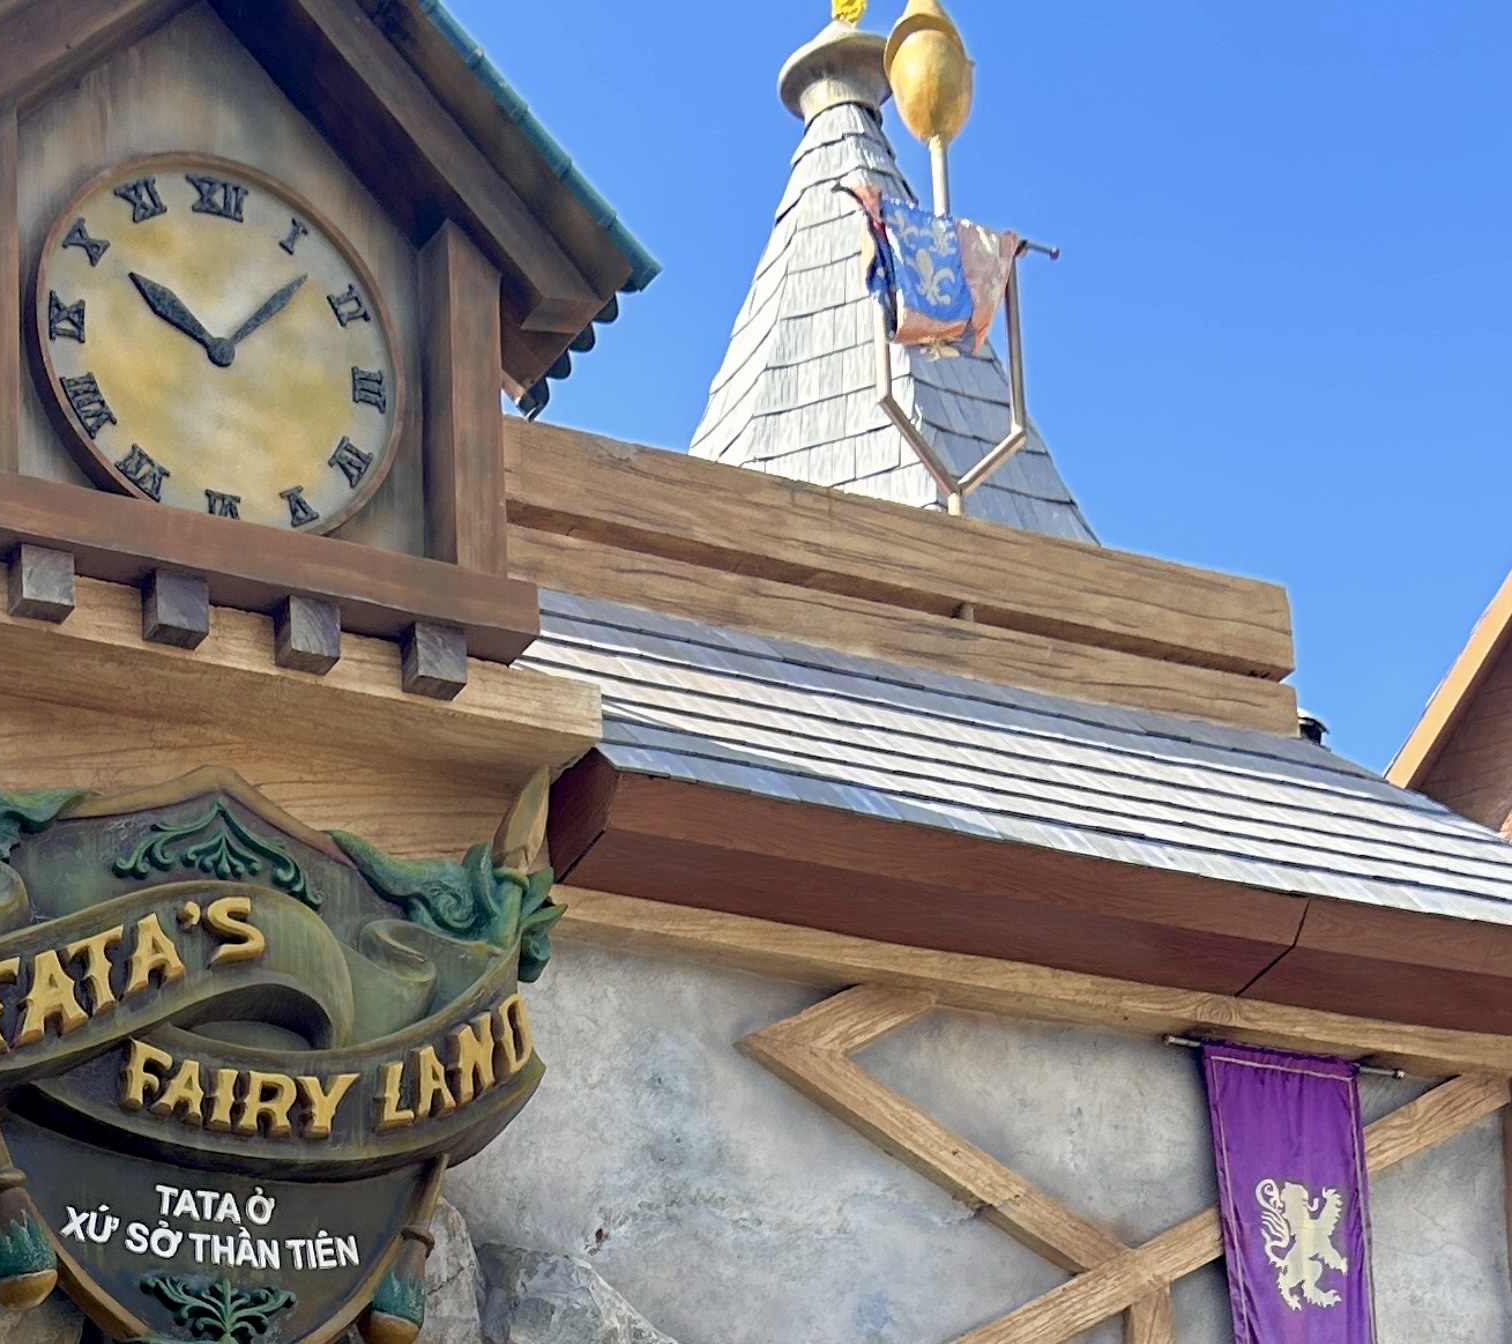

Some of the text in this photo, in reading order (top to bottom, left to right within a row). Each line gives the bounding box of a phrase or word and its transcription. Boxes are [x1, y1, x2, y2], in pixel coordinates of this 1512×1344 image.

[114, 177, 167, 223] XI
[186, 174, 249, 223] XII
[62, 217, 110, 267] X
[279, 217, 308, 255] I
[48, 290, 86, 343] IX
[327, 284, 371, 327] II
[59, 371, 117, 440] VIII
[352, 365, 387, 413] III
[114, 443, 170, 503] VII
[278, 485, 320, 527] V
[119, 993, 536, 1141] FAIRY LAND
[155, 1184, 276, 1226] TATA Ở
[59, 1204, 360, 1271] XỨ SỞ THẦN TIÊN
